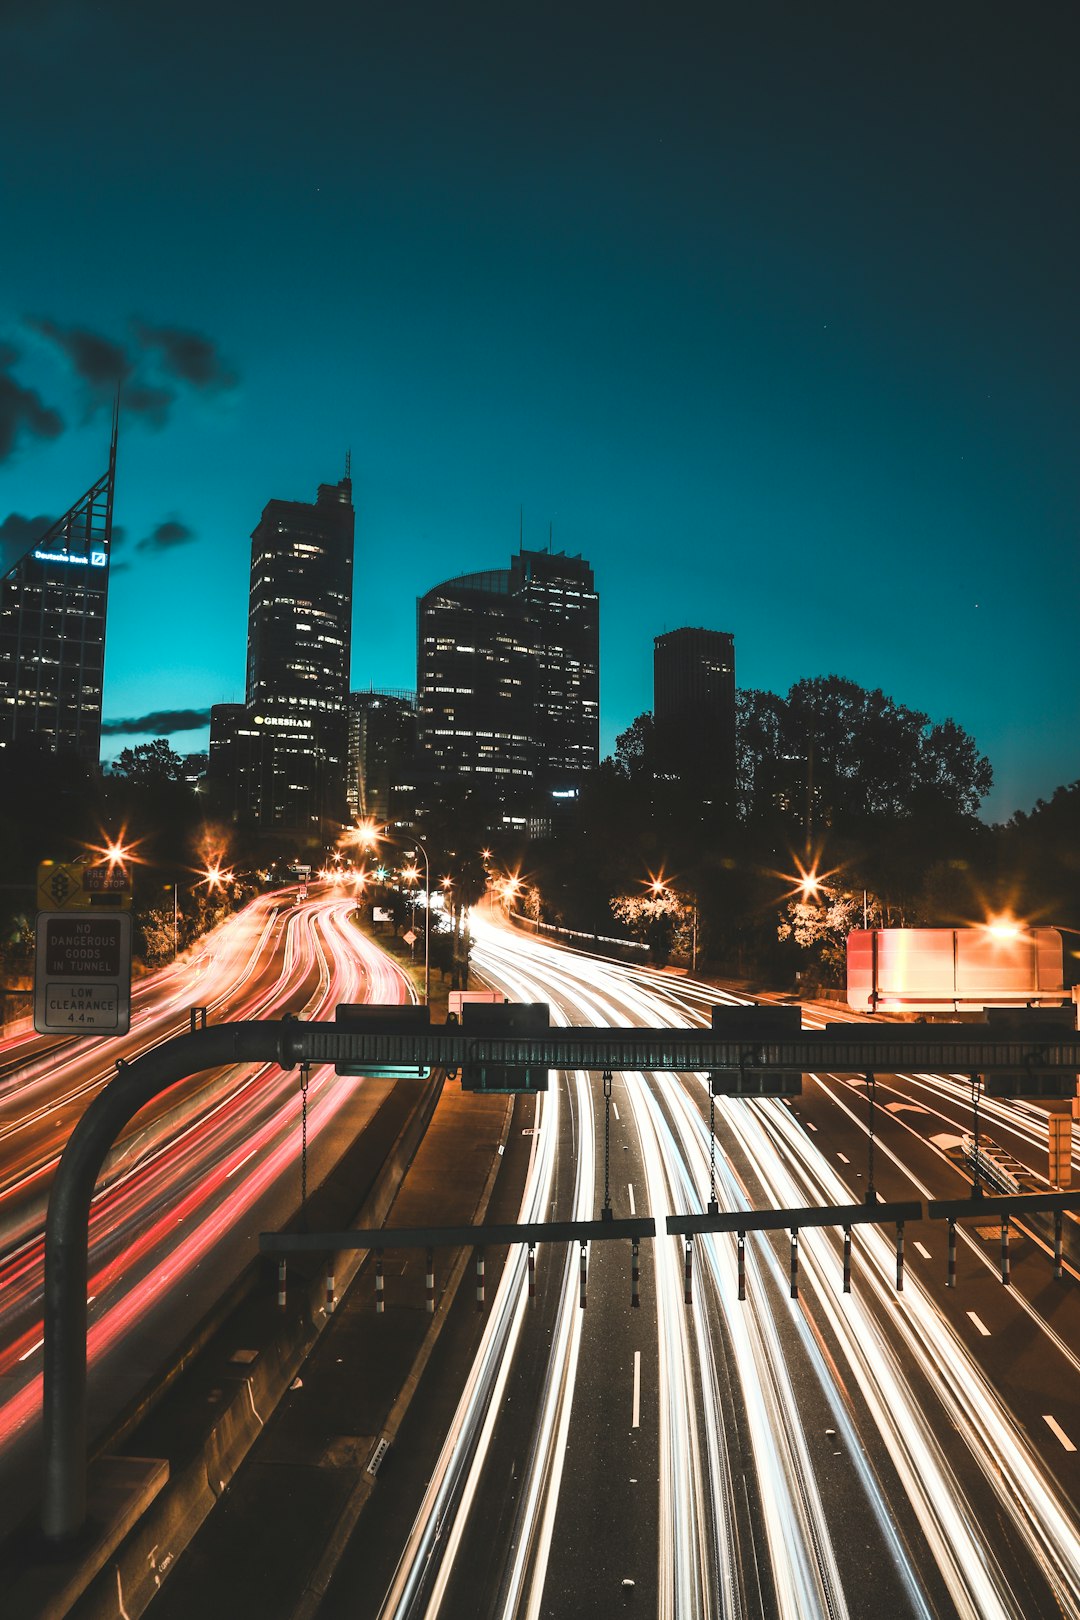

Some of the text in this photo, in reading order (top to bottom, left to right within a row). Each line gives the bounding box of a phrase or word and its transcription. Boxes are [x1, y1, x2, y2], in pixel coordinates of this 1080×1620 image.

[35, 551, 88, 564] Deutsche Bank
[264, 717, 311, 728] GRESHAM
[87, 869, 128, 878] PREPARE
[88, 880, 125, 888] TO STOP
[76, 924, 91, 933] NO
[51, 936, 116, 946] DANGEROUS
[65, 949, 101, 959] GOODS
[53, 961, 112, 972] IN TUNNEL
[71, 988, 93, 998] LOW
[50, 1000, 114, 1010] CLEARANCE
